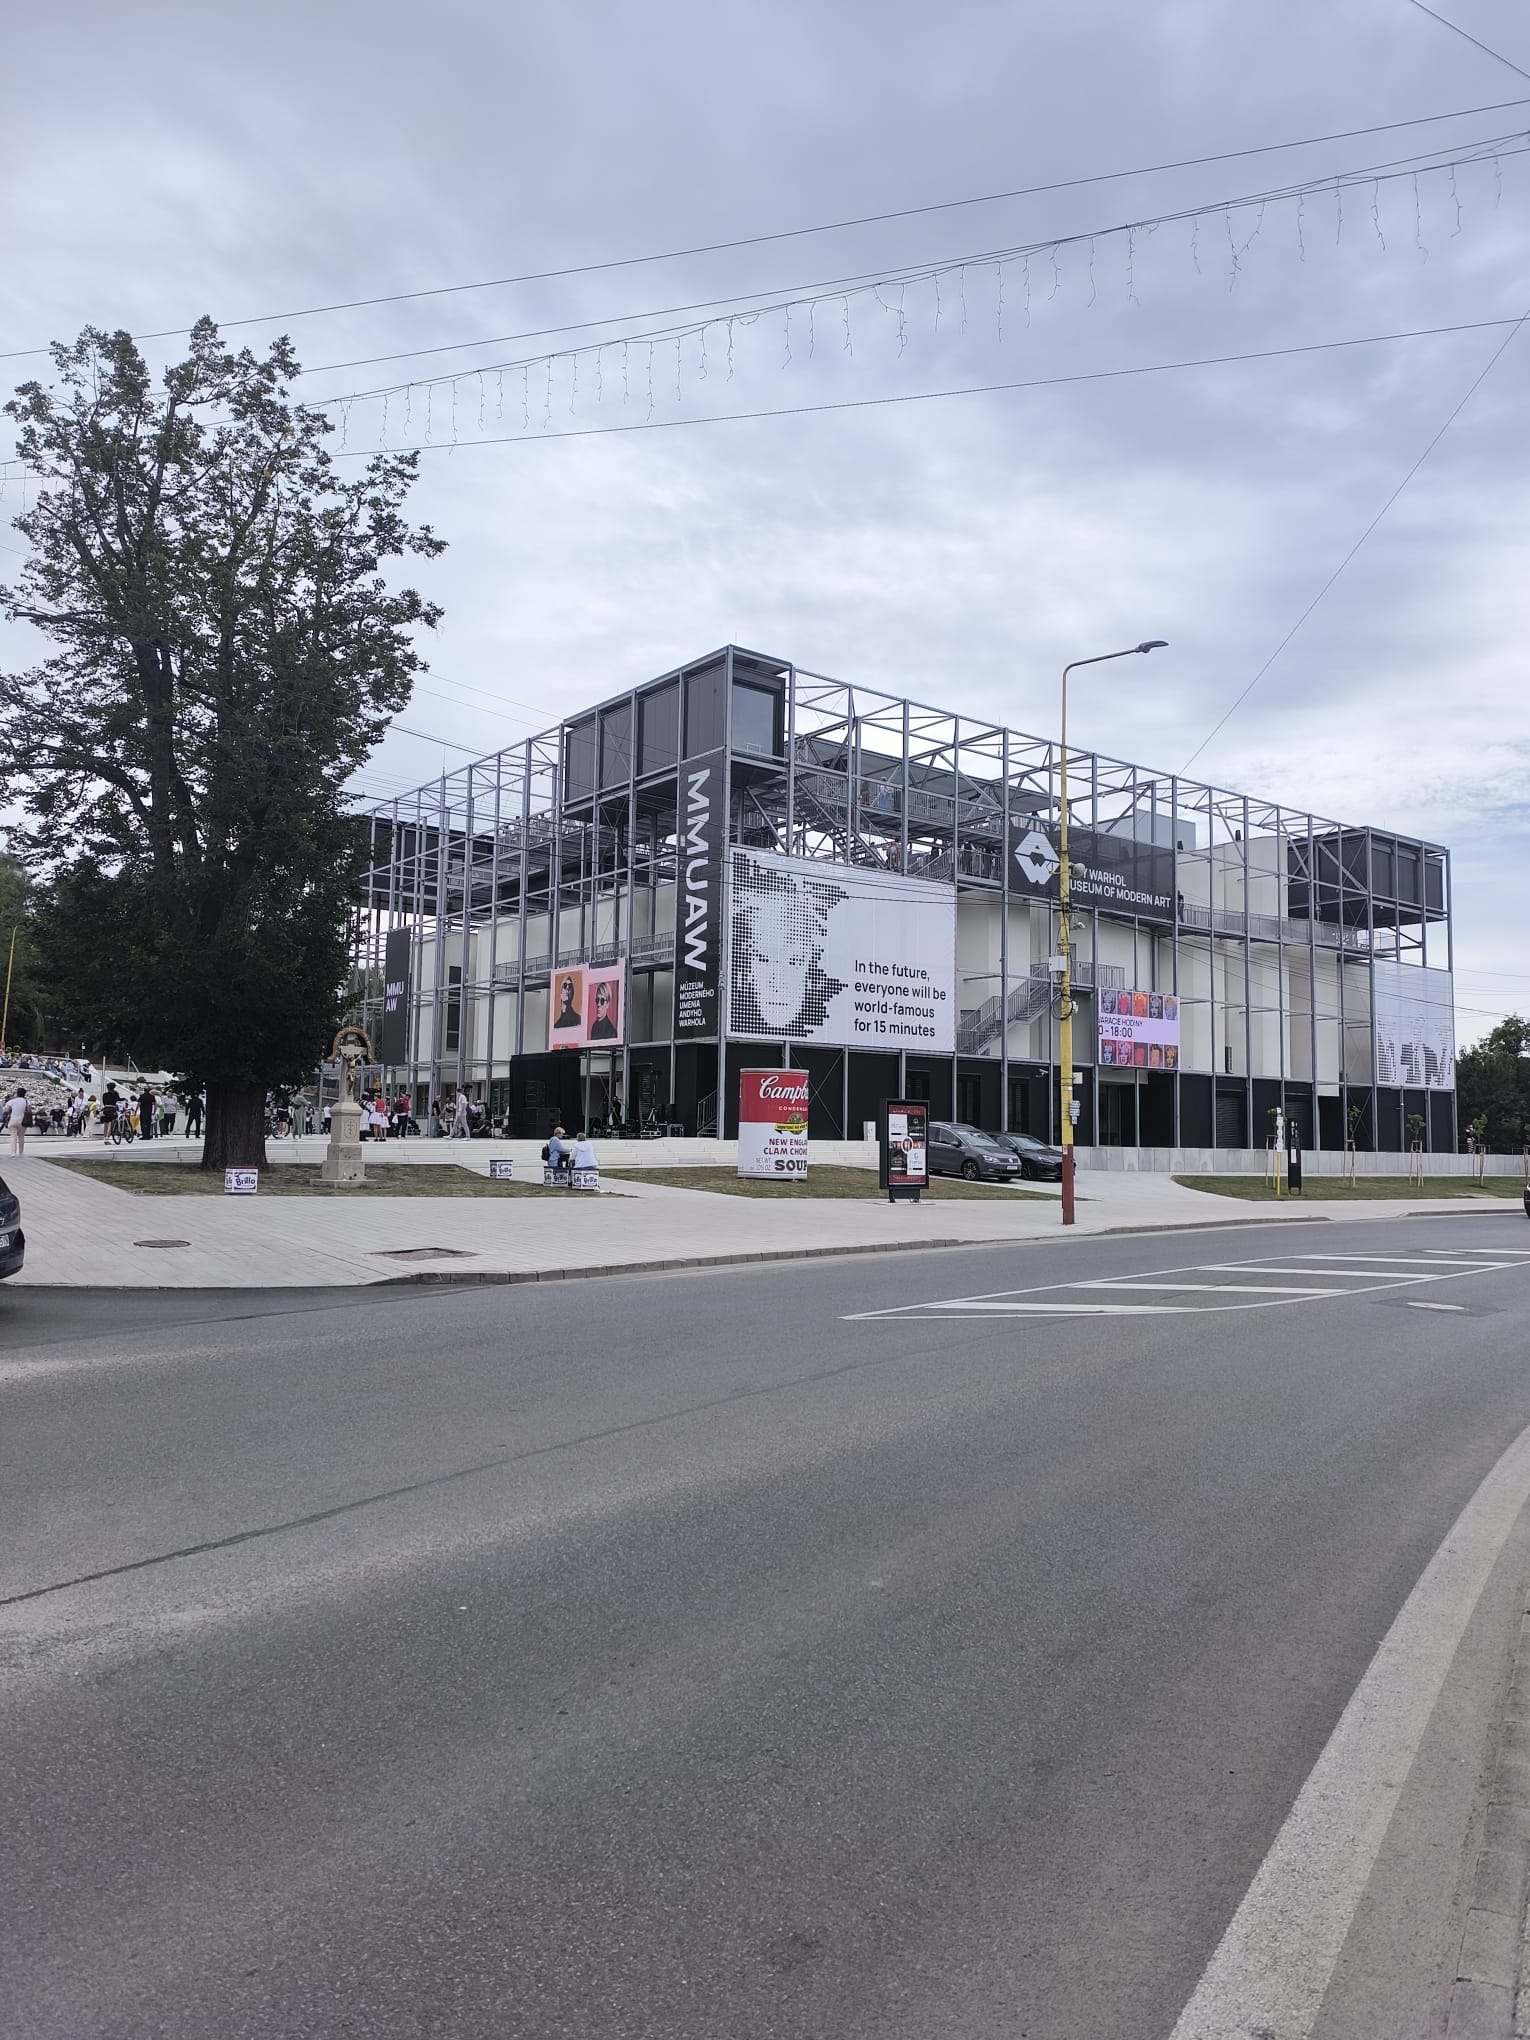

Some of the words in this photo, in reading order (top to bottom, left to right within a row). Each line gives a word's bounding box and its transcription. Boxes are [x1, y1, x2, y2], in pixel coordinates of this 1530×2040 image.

[684, 768, 711, 972] MMUAW
[1089, 869, 1127, 887] WARHOL
[1070, 880, 1103, 896] USEUM
[1104, 885, 1115, 898] OF
[1116, 889, 1153, 906] MODERN
[1154, 895, 1172, 909] ART
[855, 960, 866, 973] In
[868, 961, 889, 975] the
[892, 963, 930, 982] future,
[386, 980, 405, 997] MMU
[854, 981, 909, 998] everyone
[912, 985, 931, 999] will
[933, 987, 947, 1000] be
[385, 998, 398, 1013] AW
[679, 999, 701, 1010] UMENIA
[854, 1001, 935, 1018] world-famous
[679, 1008, 703, 1019] ANDYHO
[678, 1017, 707, 1028] WARHOLA
[854, 1018, 871, 1032] for
[873, 1020, 887, 1033] 15
[889, 1021, 936, 1037] minutes
[1121, 1019, 1144, 1028] HODINY
[1110, 1026, 1133, 1038] 18:00
[768, 1138, 788, 1146] NEW
[763, 1147, 788, 1155] CLAM
[235, 1176, 256, 1186] Brillo
